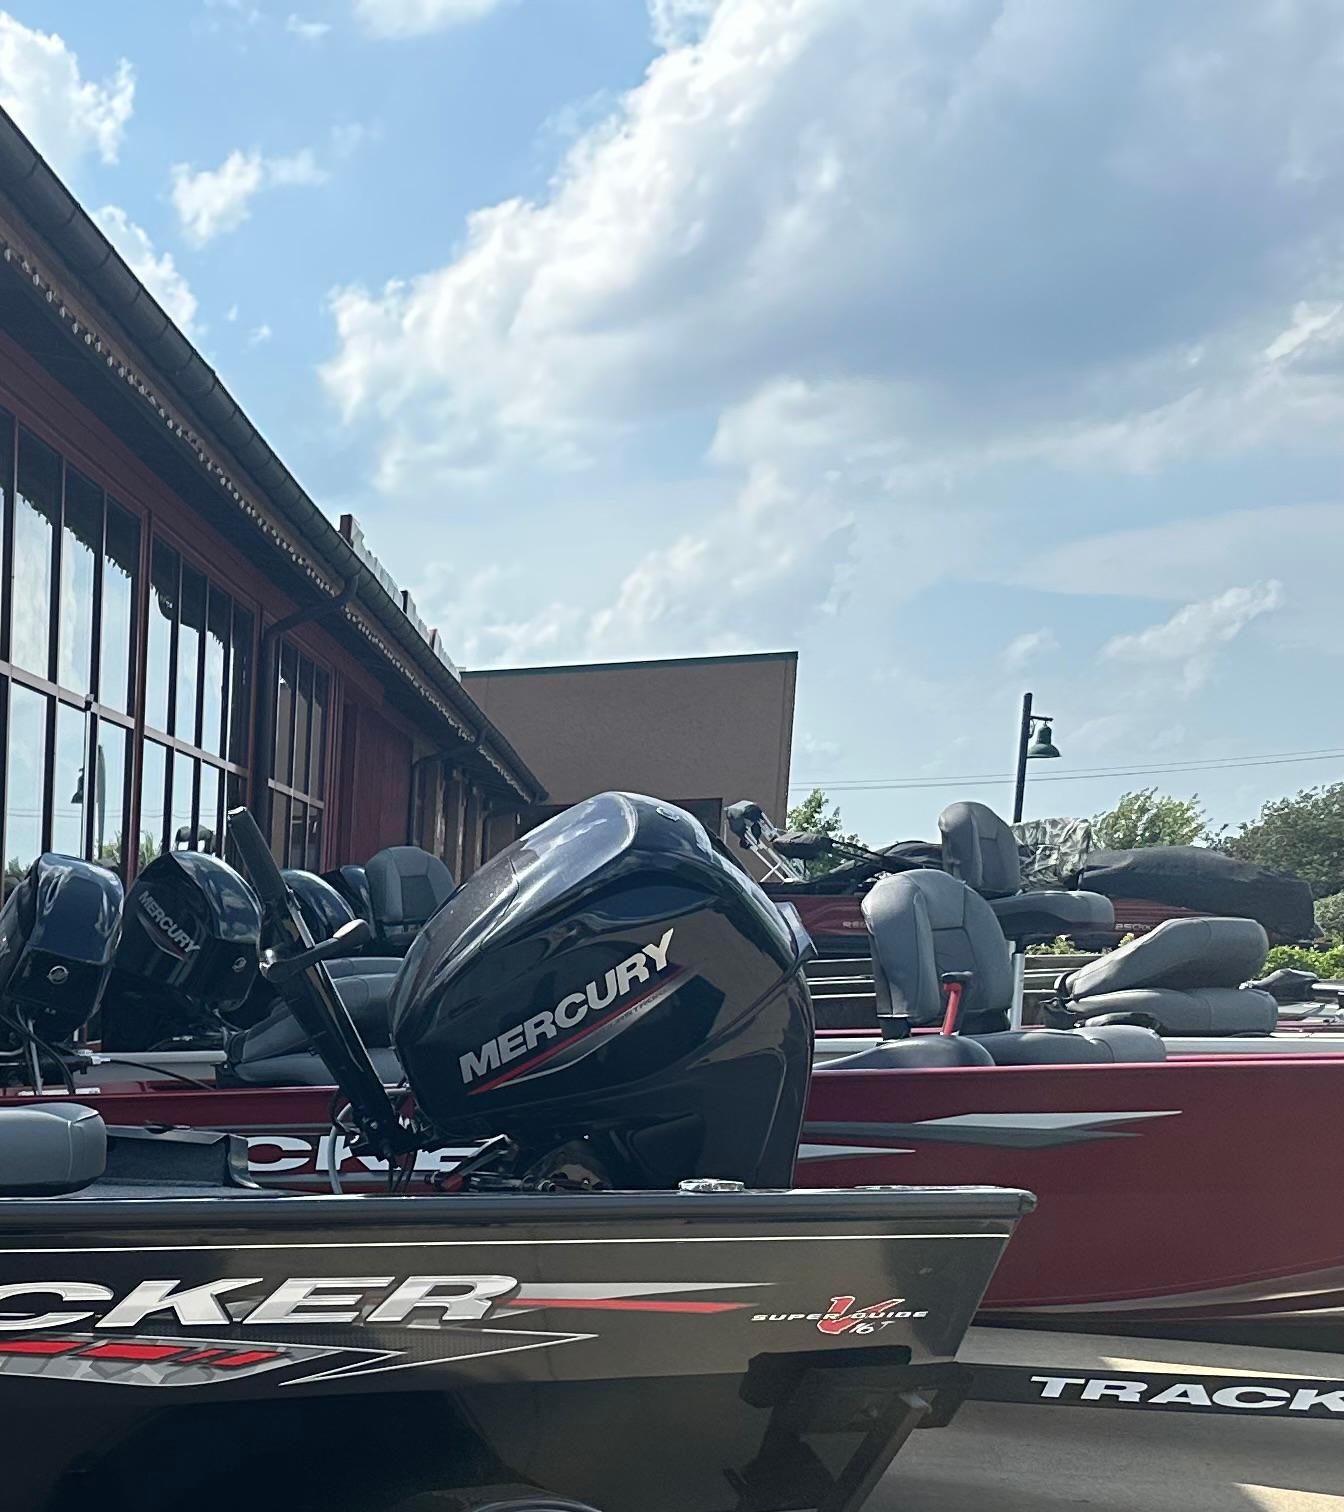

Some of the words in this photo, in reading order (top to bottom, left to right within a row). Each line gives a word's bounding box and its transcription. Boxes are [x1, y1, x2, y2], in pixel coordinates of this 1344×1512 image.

[138, 890, 201, 954] MERCURY
[458, 927, 674, 1084] MERCURY
[750, 1312, 840, 1321] SUPER
[851, 1310, 929, 1320] GUIDE
